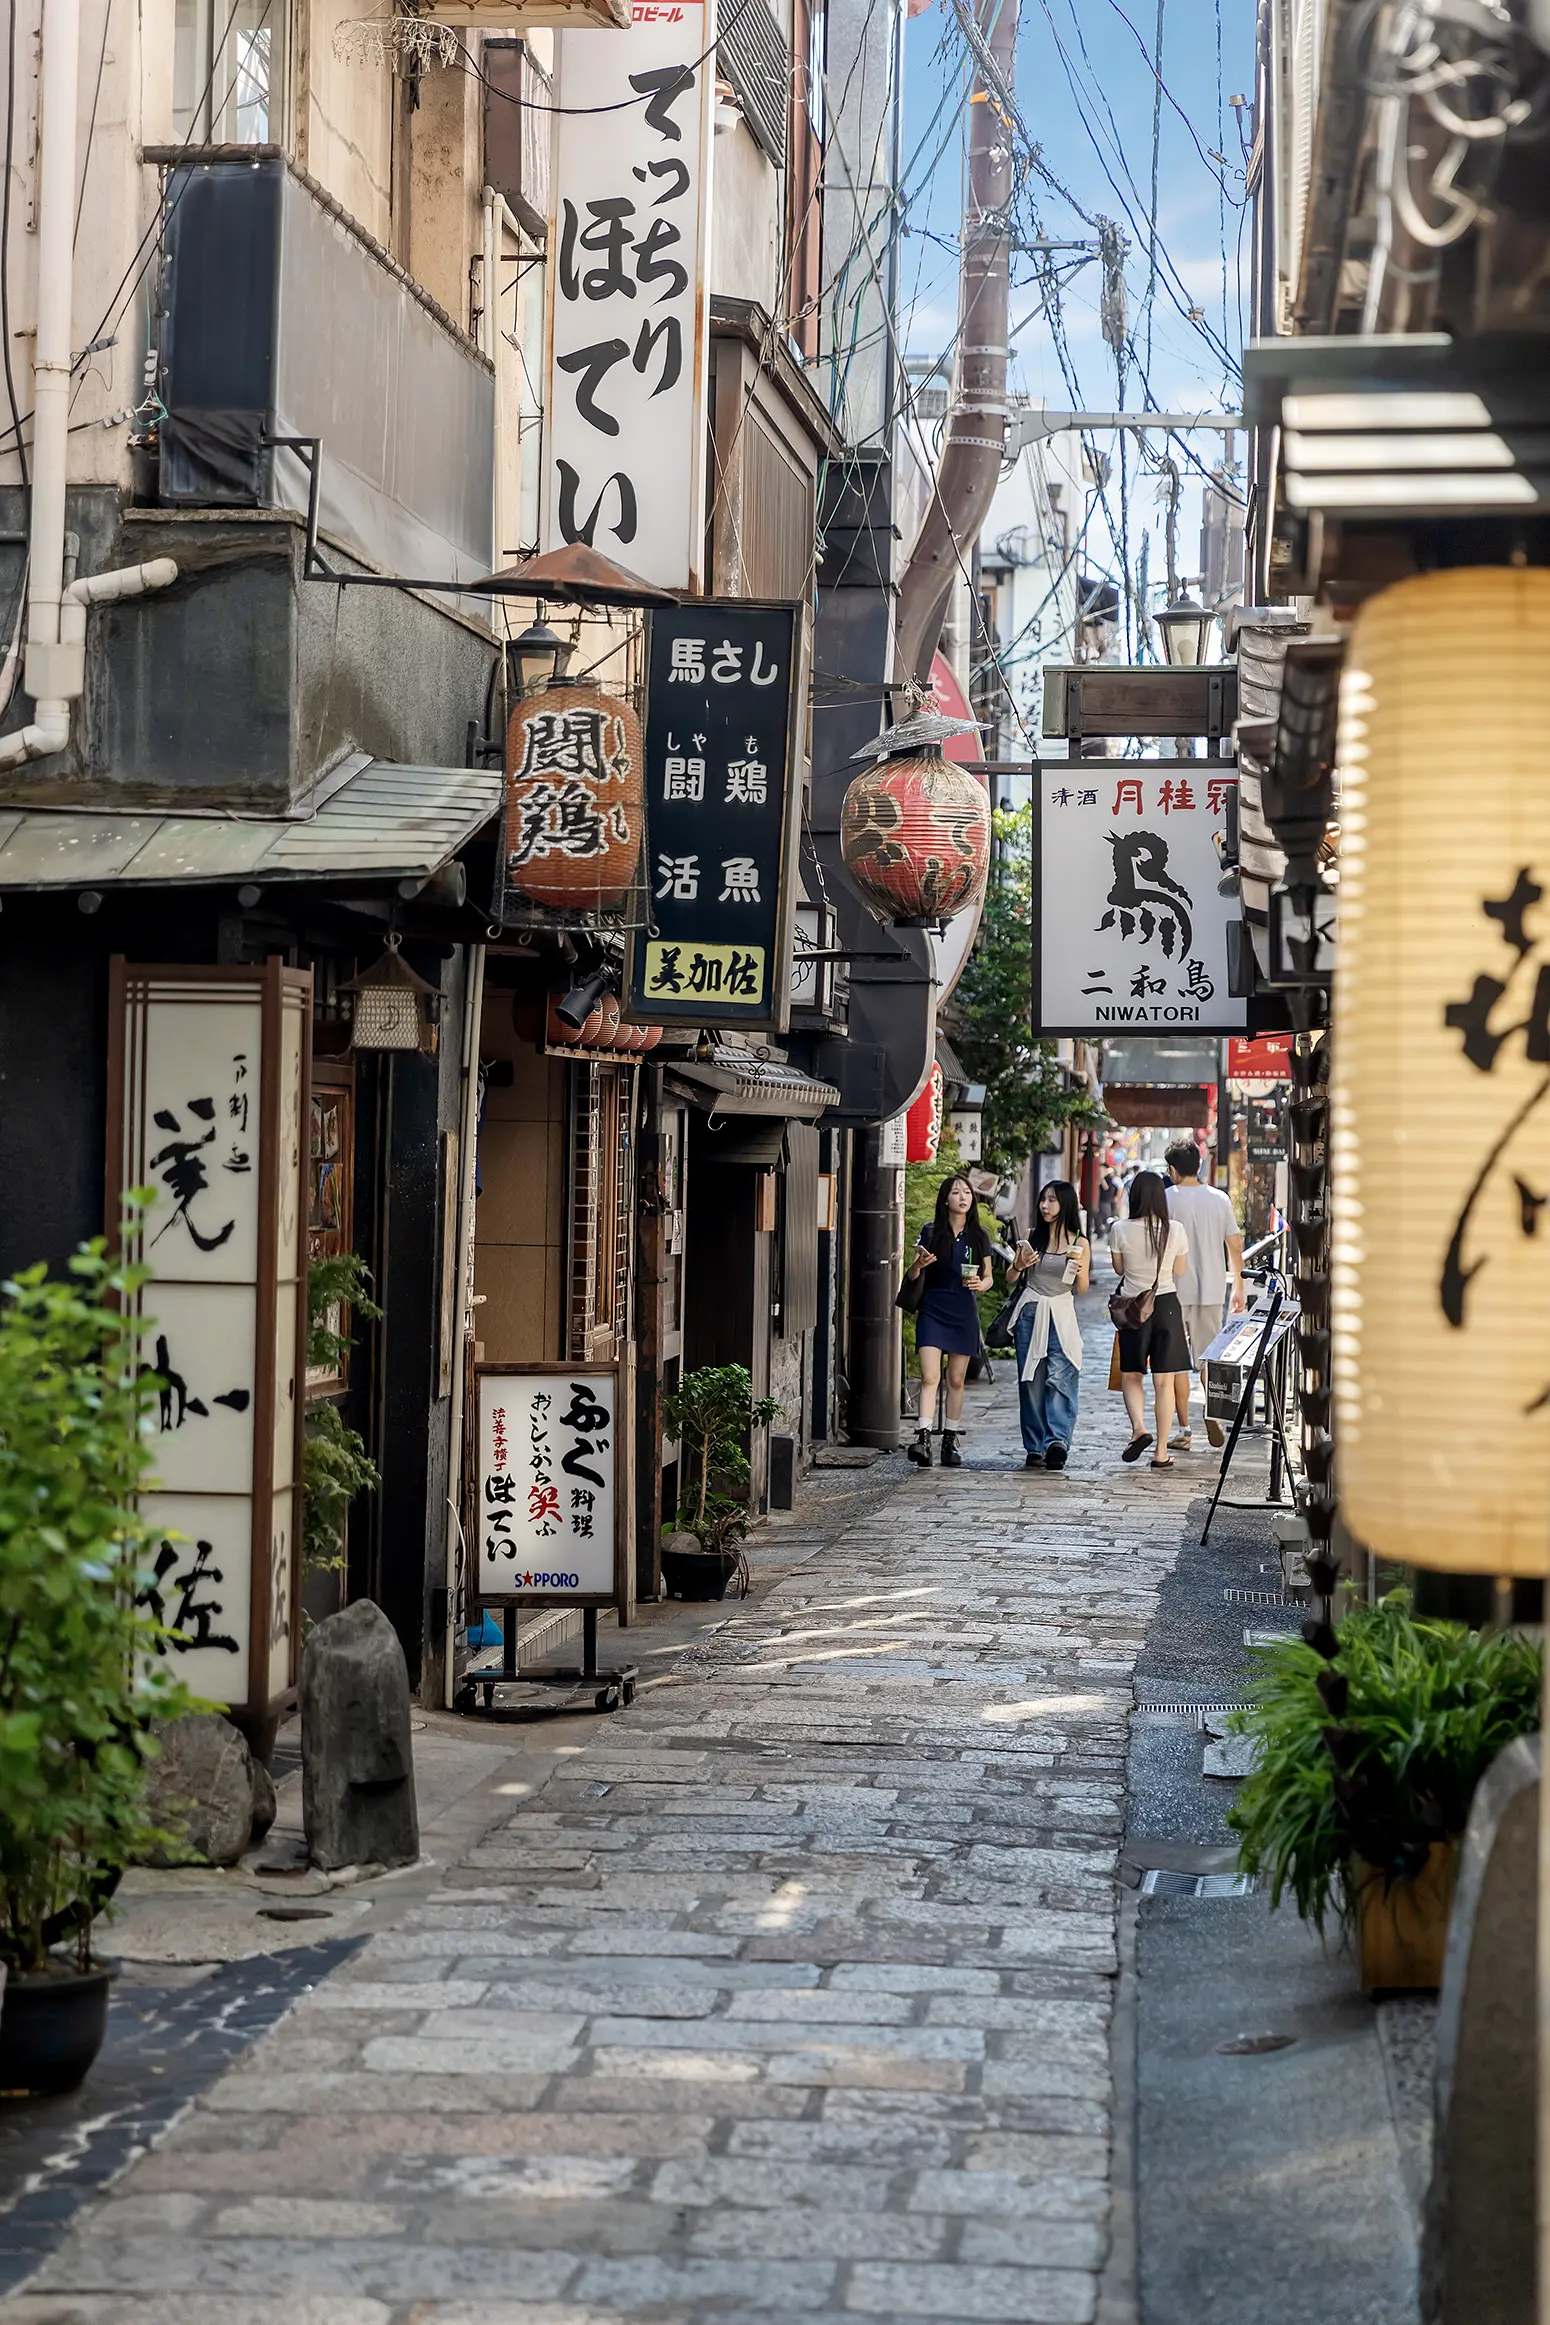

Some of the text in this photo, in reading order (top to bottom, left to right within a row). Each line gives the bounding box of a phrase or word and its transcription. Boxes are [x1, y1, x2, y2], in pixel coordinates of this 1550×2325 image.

[628, 64, 696, 401] てっちり
[556, 196, 638, 548] ほてい
[668, 638, 779, 686] 馬さし
[663, 757, 768, 805] 闘鶏
[1051, 787, 1099, 808] 清酒
[655, 854, 761, 903] 活魚
[649, 946, 761, 996] 美加佐
[1081, 958, 1215, 1003] 二和鳥
[1095, 1006, 1200, 1021] NIWATORI
[485, 1407, 518, 1562] 法善寺横丁 ほてい
